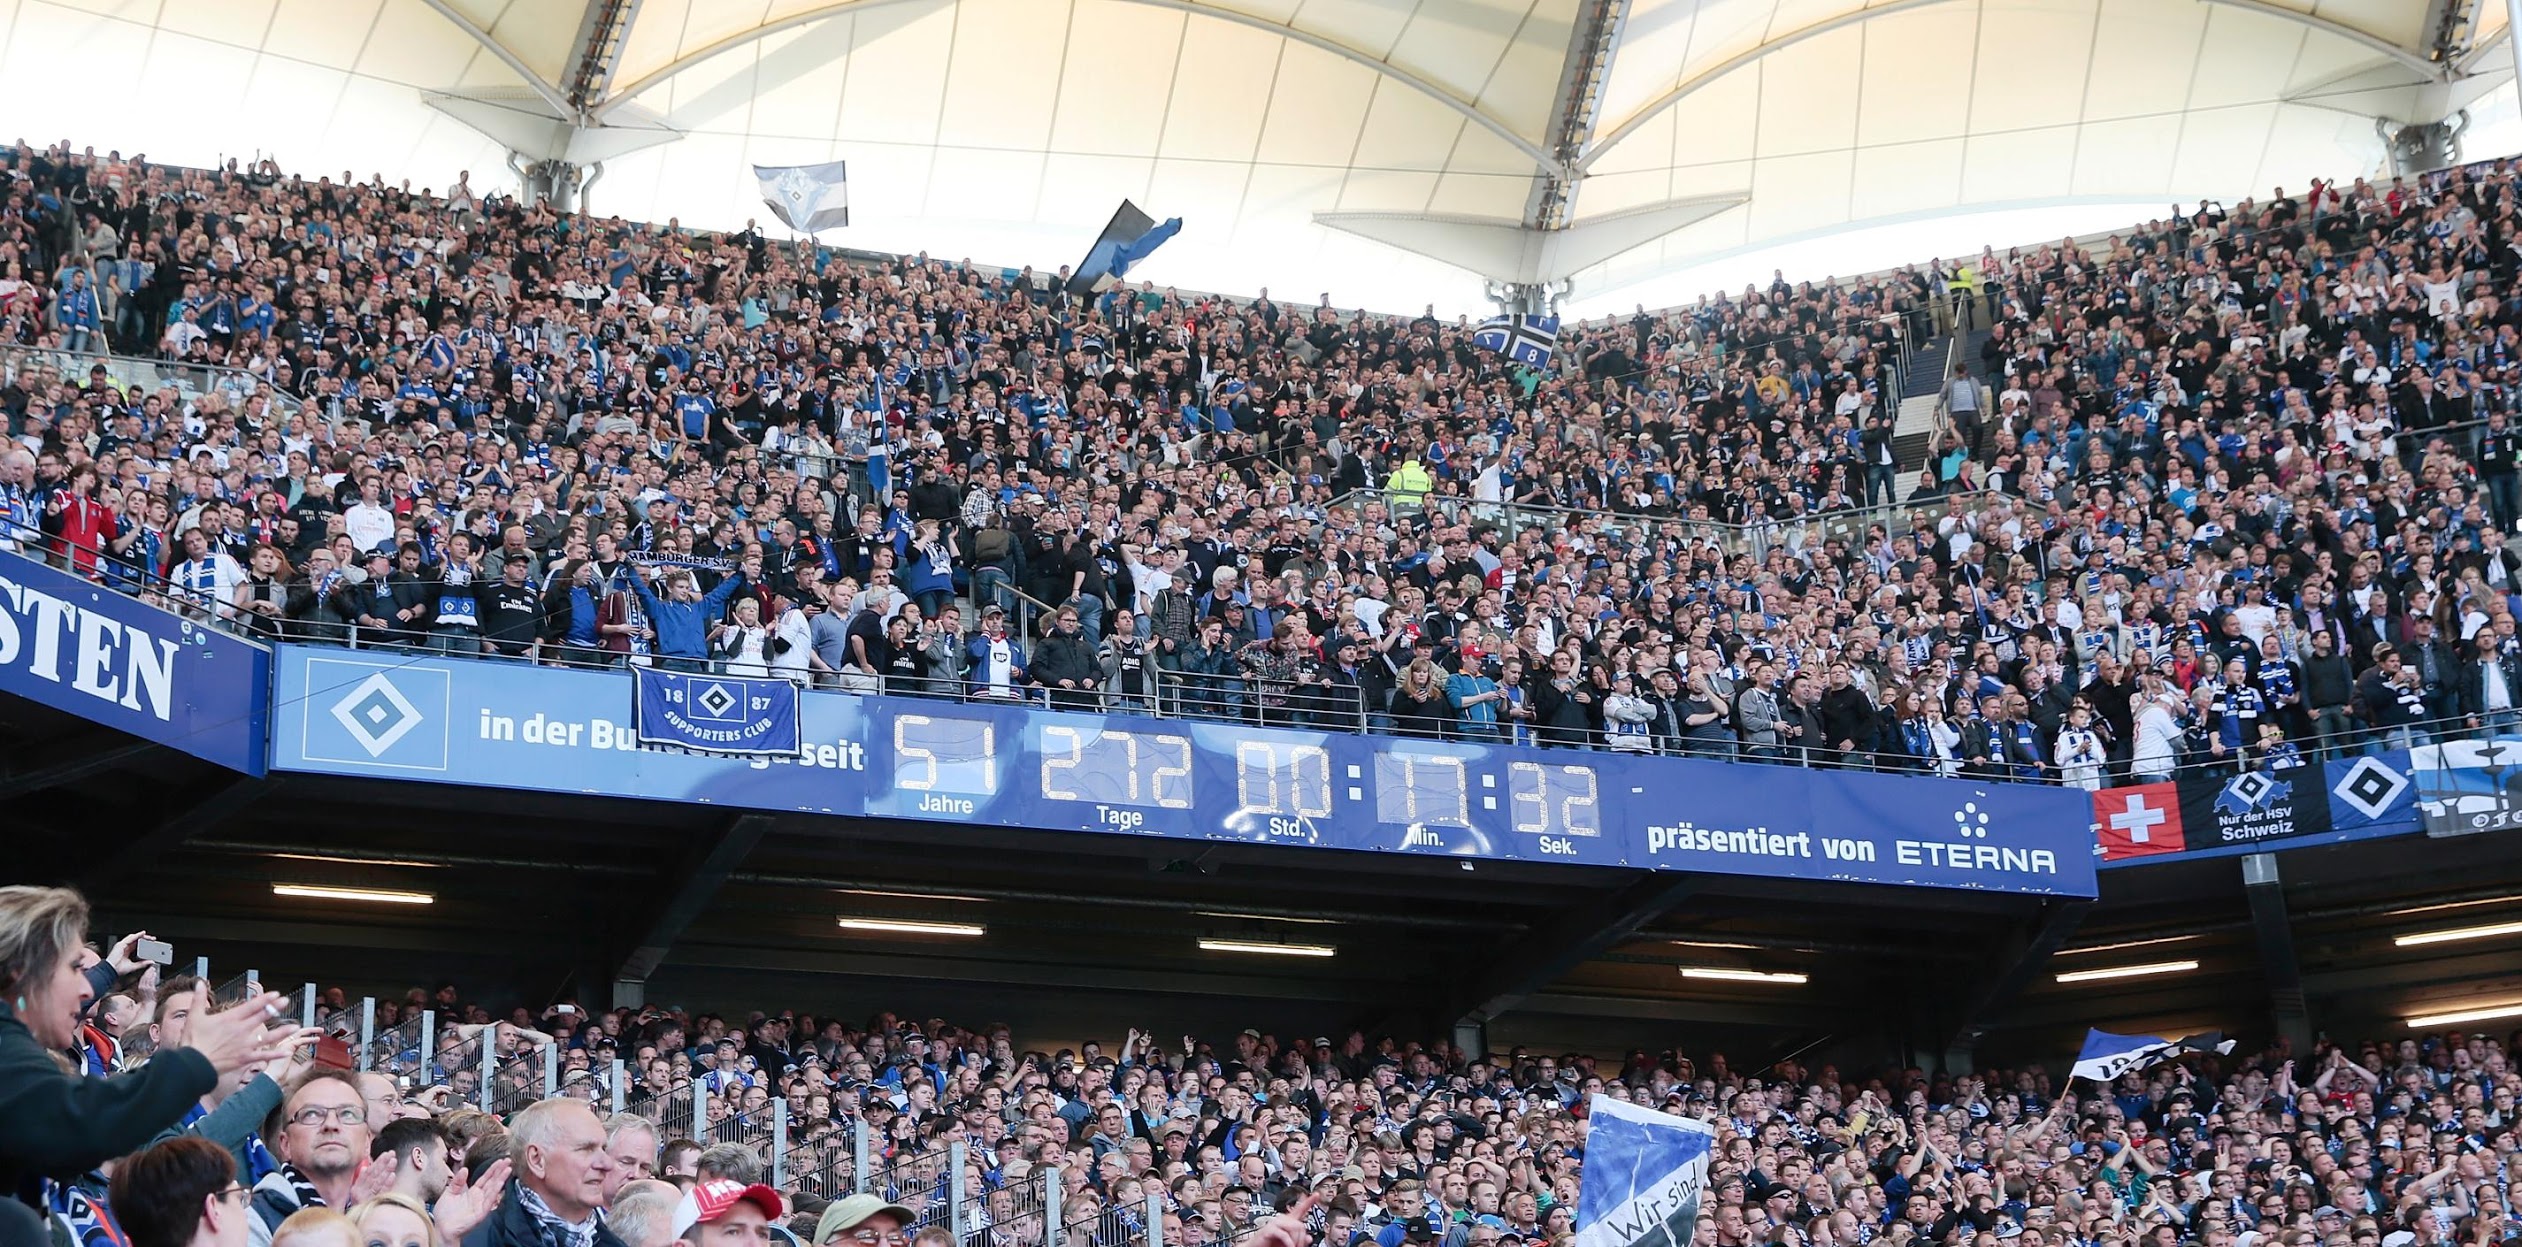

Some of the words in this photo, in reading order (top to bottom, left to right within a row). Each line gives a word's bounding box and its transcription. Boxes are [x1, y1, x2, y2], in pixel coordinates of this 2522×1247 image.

[664, 688, 684, 704] 18
[751, 697, 771, 711] 87
[480, 708, 514, 742] in
[522, 712, 585, 748] der
[664, 710, 741, 742] SUPPORTERS
[743, 717, 773, 739] CLUB
[798, 738, 864, 771] seit
[1041, 725, 1192, 808] 272
[918, 794, 974, 814] Jahre
[2218, 815, 2242, 827] Nur
[2243, 811, 2263, 823] der
[2265, 806, 2293, 819] HSV
[1096, 805, 1143, 832] Tage
[1269, 817, 1306, 838] Std.
[2221, 821, 2294, 841] Schweiz
[1406, 826, 1445, 847] Min.
[1539, 835, 1577, 855] Sek.
[1647, 821, 1811, 859] präsentiert
[1821, 836, 1876, 862] von
[1896, 839, 2057, 874] ETERNA
[1607, 1199, 1663, 1242] Wir
[1667, 1162, 1699, 1208] sind
